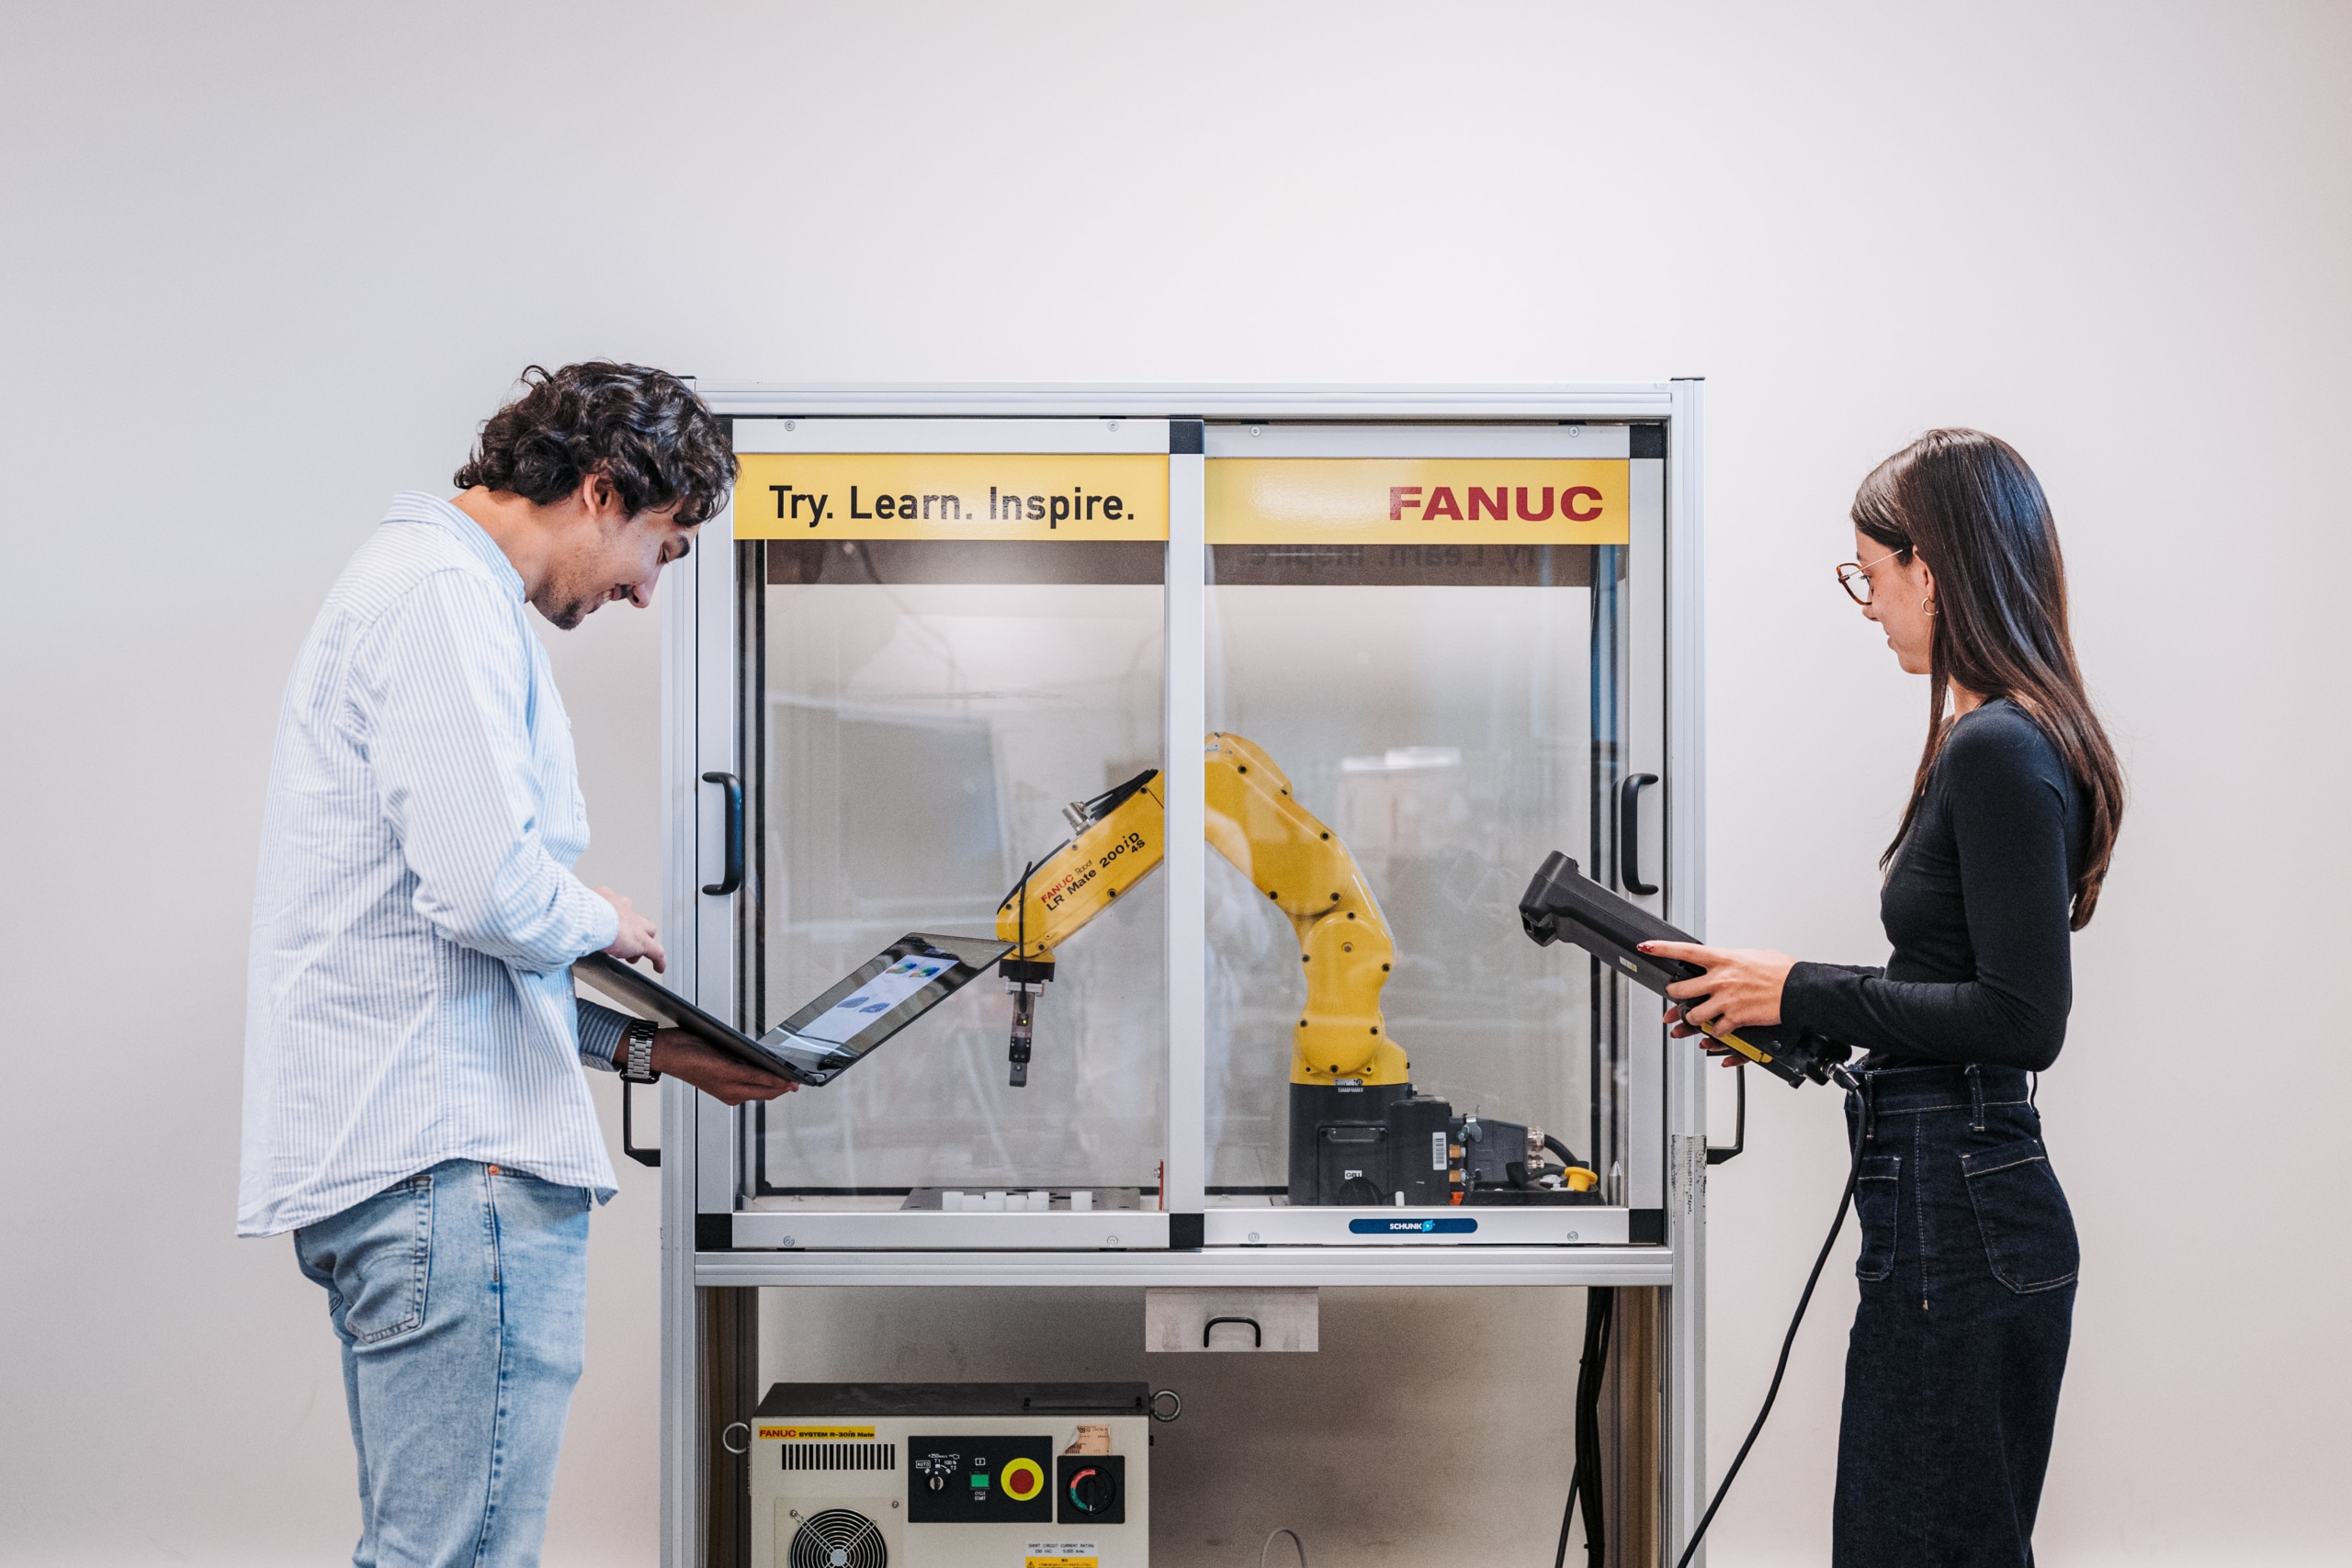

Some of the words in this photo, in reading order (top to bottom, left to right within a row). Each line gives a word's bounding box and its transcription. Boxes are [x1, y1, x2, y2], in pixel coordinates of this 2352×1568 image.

[769, 485, 833, 527] Try.
[850, 485, 973, 521] Learn.
[989, 486, 1135, 529] Inspire.
[1389, 485, 1604, 522] FANUC
[1131, 840, 1146, 853] 4S
[1040, 874, 1074, 903] FANUC
[1075, 860, 1092, 875] Robot
[1046, 895, 1065, 911] LR
[1067, 869, 1097, 895] Mate
[1099, 832, 1140, 868] 200iD
[759, 1429, 797, 1438] FANUC
